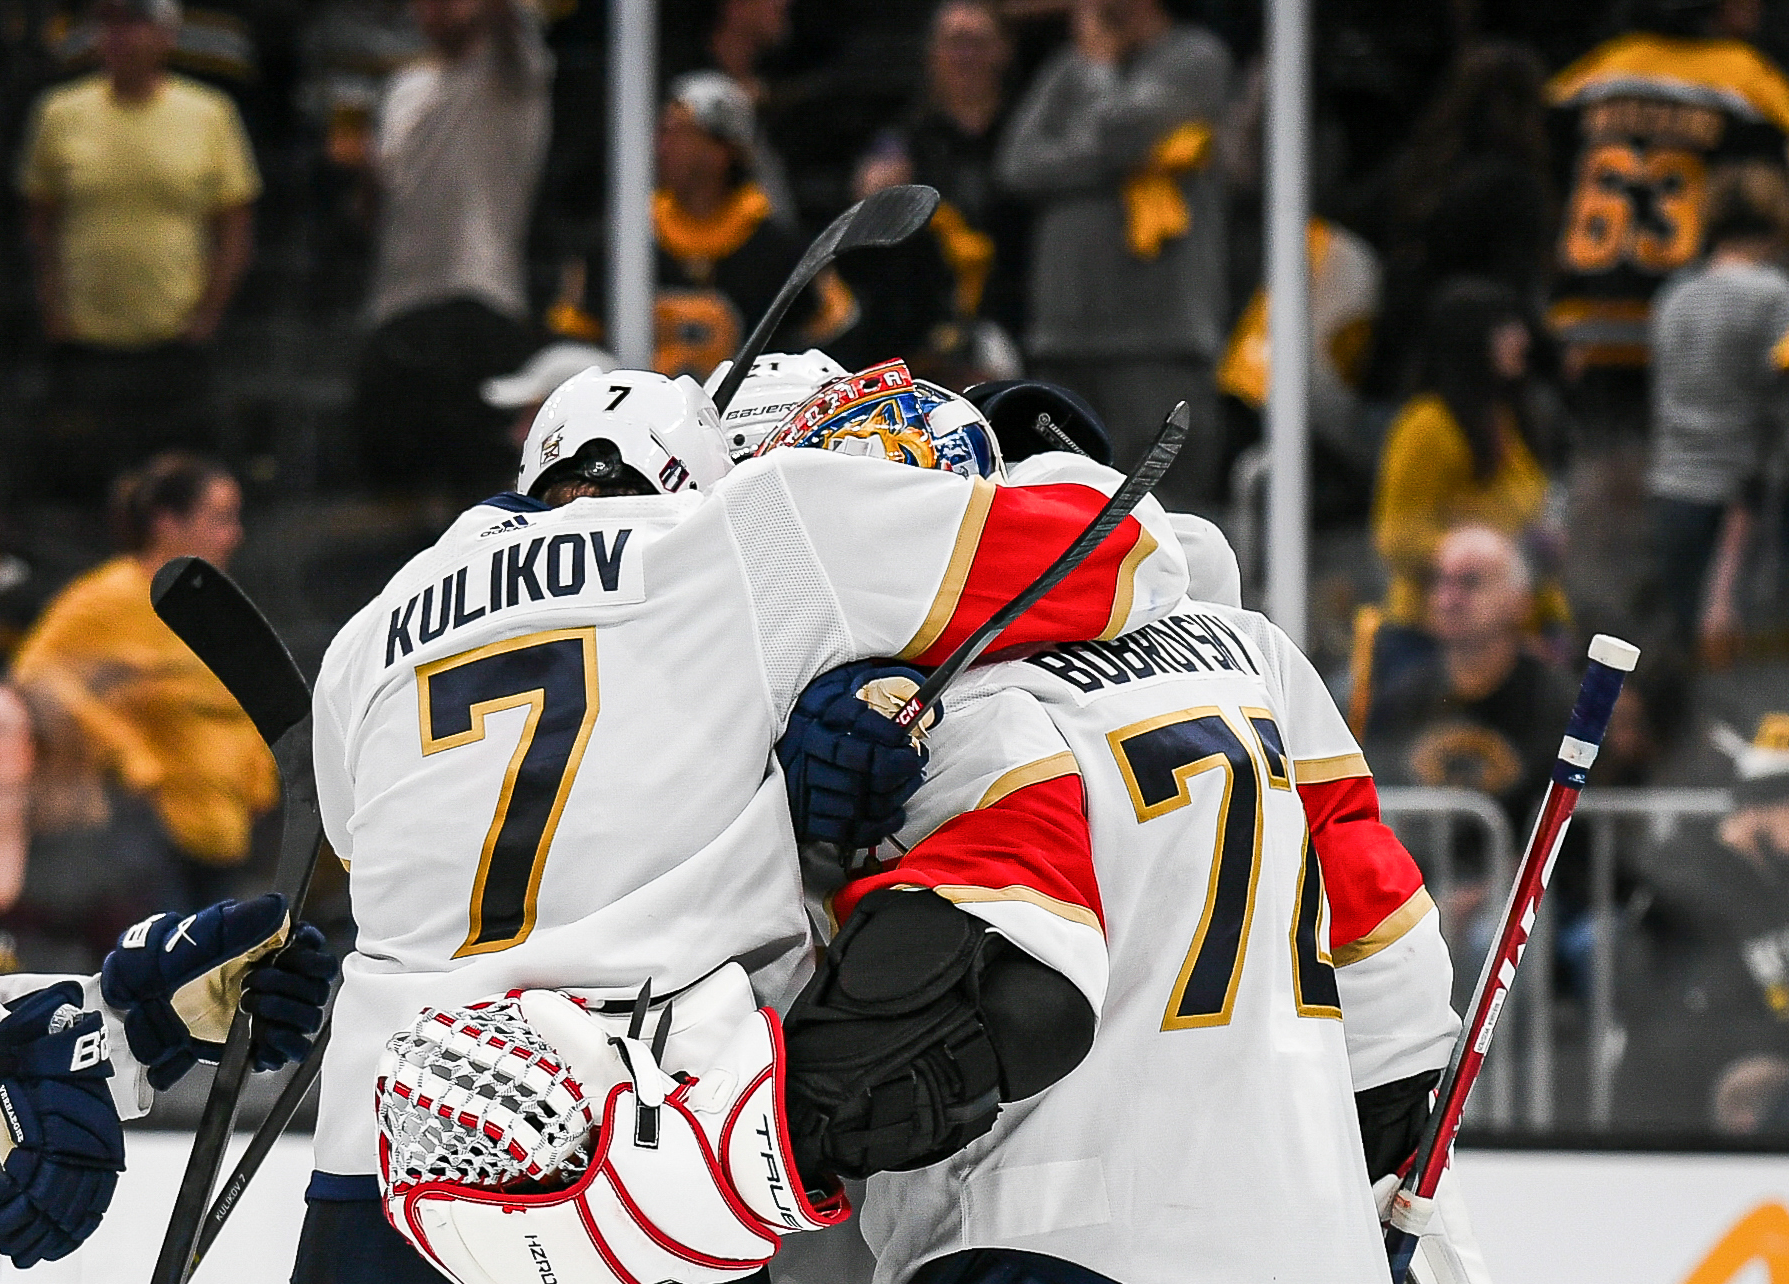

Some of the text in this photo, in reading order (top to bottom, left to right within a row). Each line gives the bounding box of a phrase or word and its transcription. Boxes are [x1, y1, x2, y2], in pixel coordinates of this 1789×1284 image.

[603, 385, 633, 413] 7
[384, 527, 633, 669] KULIKOV
[895, 698, 920, 725] CM
[414, 625, 601, 960] 7
[215, 1181, 243, 1223] KULIKOV
[751, 1112, 803, 1231] TRUE
